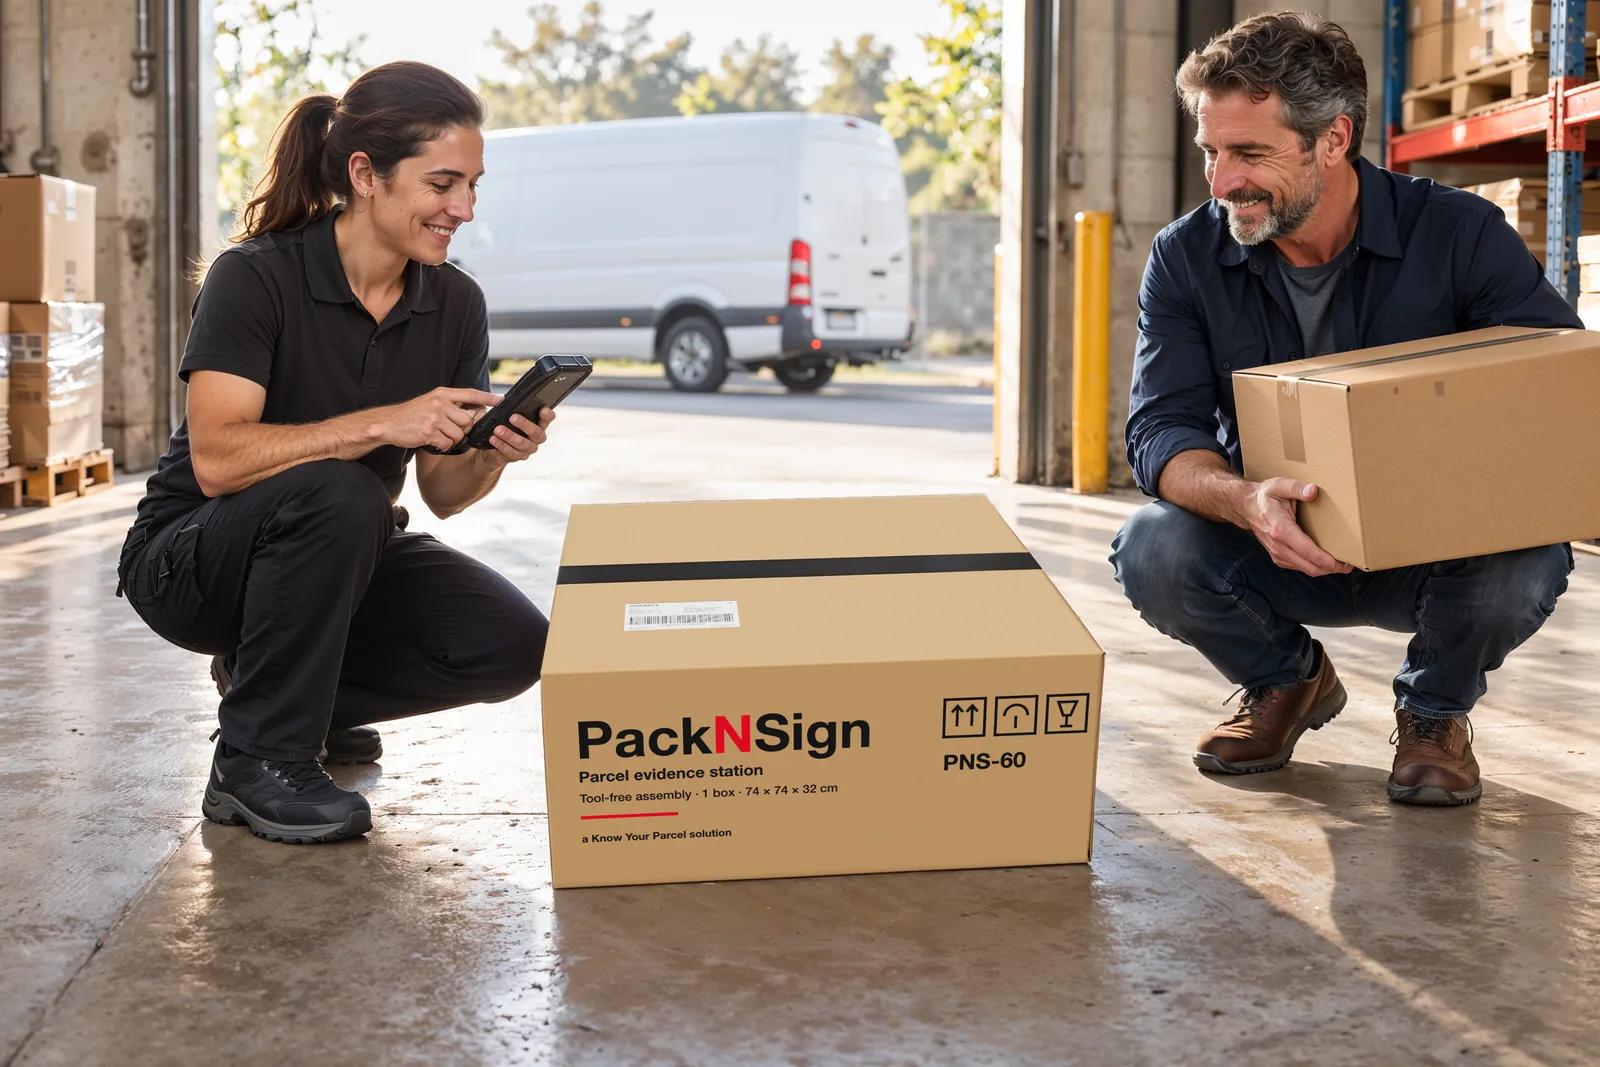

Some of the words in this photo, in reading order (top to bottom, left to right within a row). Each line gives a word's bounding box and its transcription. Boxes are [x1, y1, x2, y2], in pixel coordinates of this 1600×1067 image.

[577, 712, 871, 760] PackNSign
[943, 751, 1027, 771] PNS-60
[579, 769, 629, 784] Parcel
[633, 767, 705, 781] evidence
[709, 765, 764, 778] station
[579, 793, 633, 804] Tool-free
[635, 789, 692, 802] assembly
[702, 788, 708, 798] 1
[713, 788, 736, 798] box
[745, 786, 760, 797] 74
[774, 785, 789, 795] 74
[802, 784, 817, 794] 32
[820, 784, 838, 793] cm
[581, 836, 589, 844] a
[591, 834, 622, 843] Know
[625, 832, 650, 842] Your
[652, 831, 687, 840] Parcel
[689, 829, 732, 839] solution
